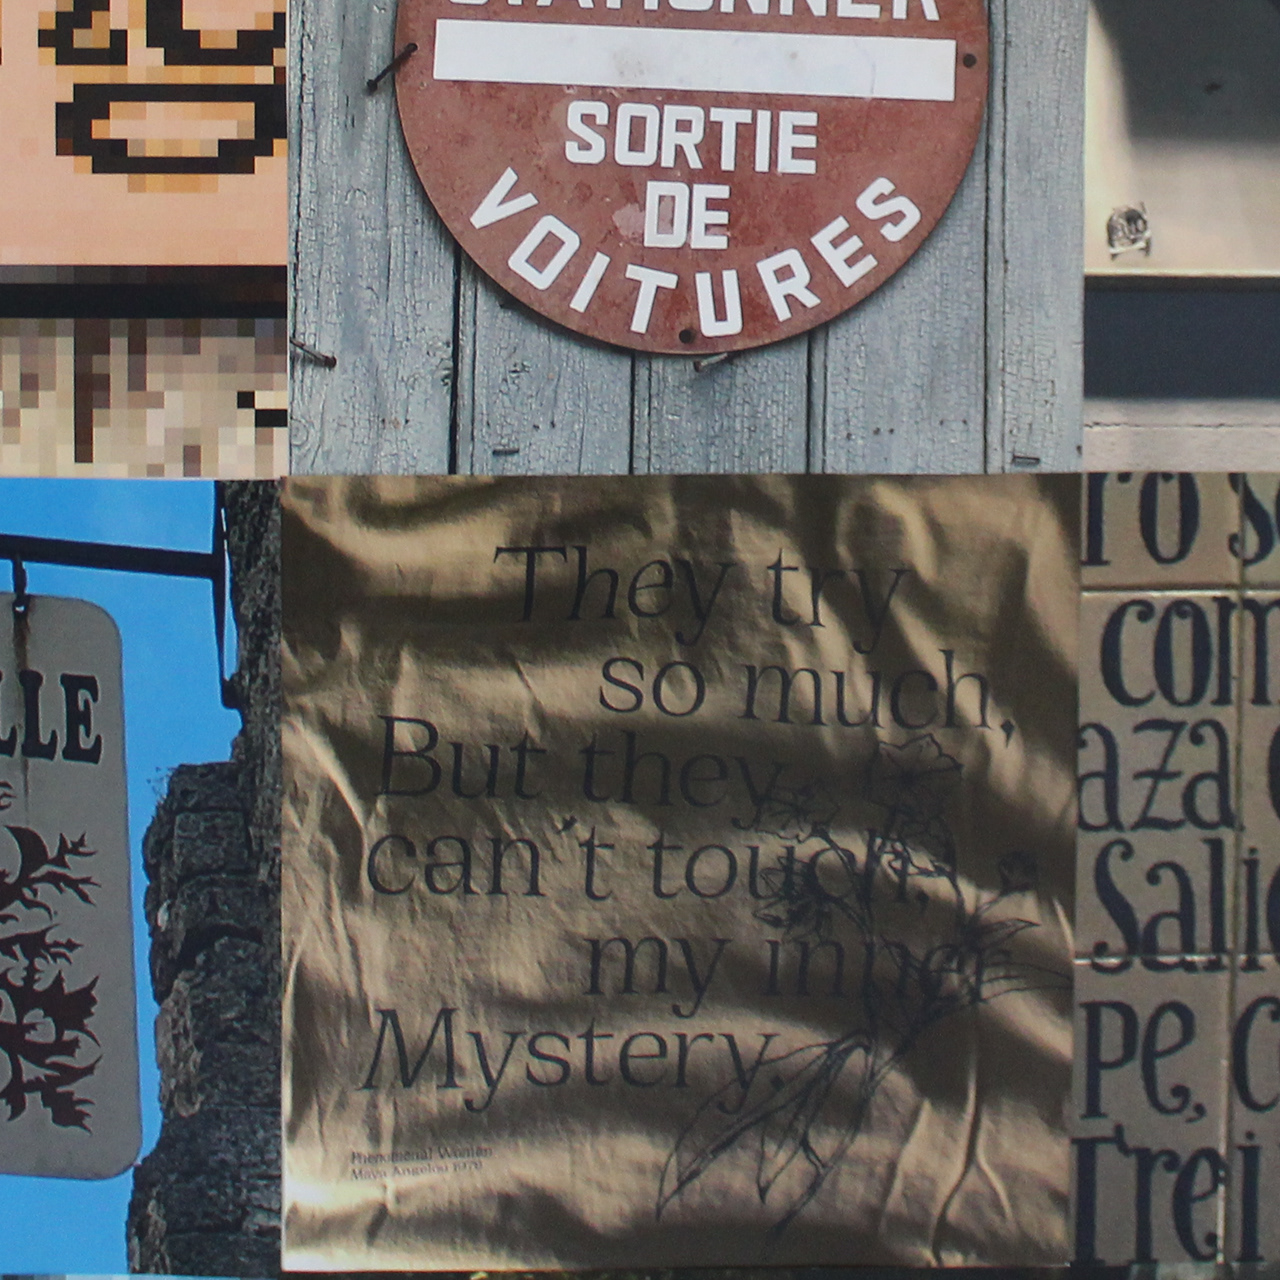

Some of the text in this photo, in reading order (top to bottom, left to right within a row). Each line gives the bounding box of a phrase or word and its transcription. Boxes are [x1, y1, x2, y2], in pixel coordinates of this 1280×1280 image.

[564, 100, 818, 174] SORTIE
[470, 167, 922, 337] VOITURES
[643, 181, 731, 250] DE
[493, 544, 911, 655] They try
[598, 656, 707, 718] so
[376, 714, 788, 830] But they
[365, 815, 616, 902] can't
[582, 934, 733, 1019] my
[358, 1006, 786, 1114] Mystery.
